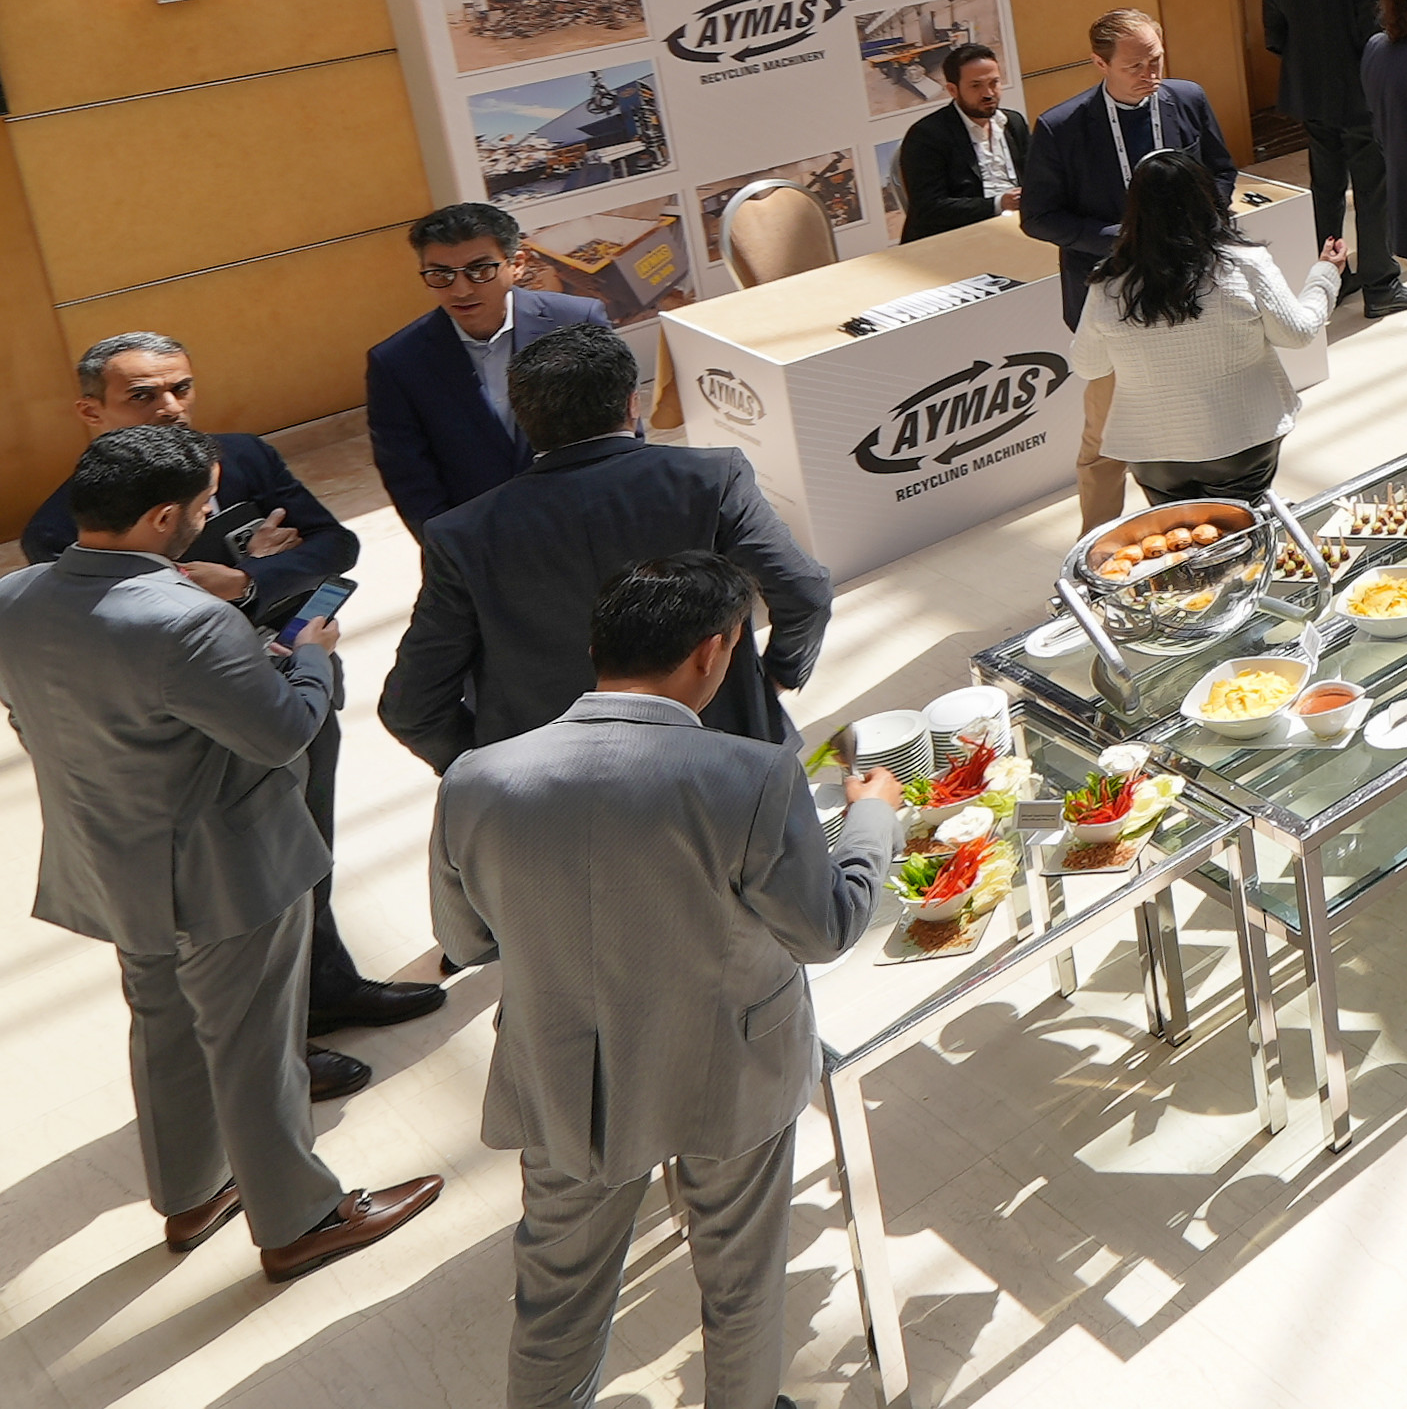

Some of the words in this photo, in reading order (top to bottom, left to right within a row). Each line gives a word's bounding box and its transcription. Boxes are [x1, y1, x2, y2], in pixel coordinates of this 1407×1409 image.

[700, 63, 761, 86] RECYCLING
[763, 49, 826, 72] MACHINERY
[708, 377, 755, 418] AYMAS
[889, 367, 1041, 457] AYMAS
[895, 463, 969, 503] RECYCLING
[972, 431, 1047, 472] MACHINERY
